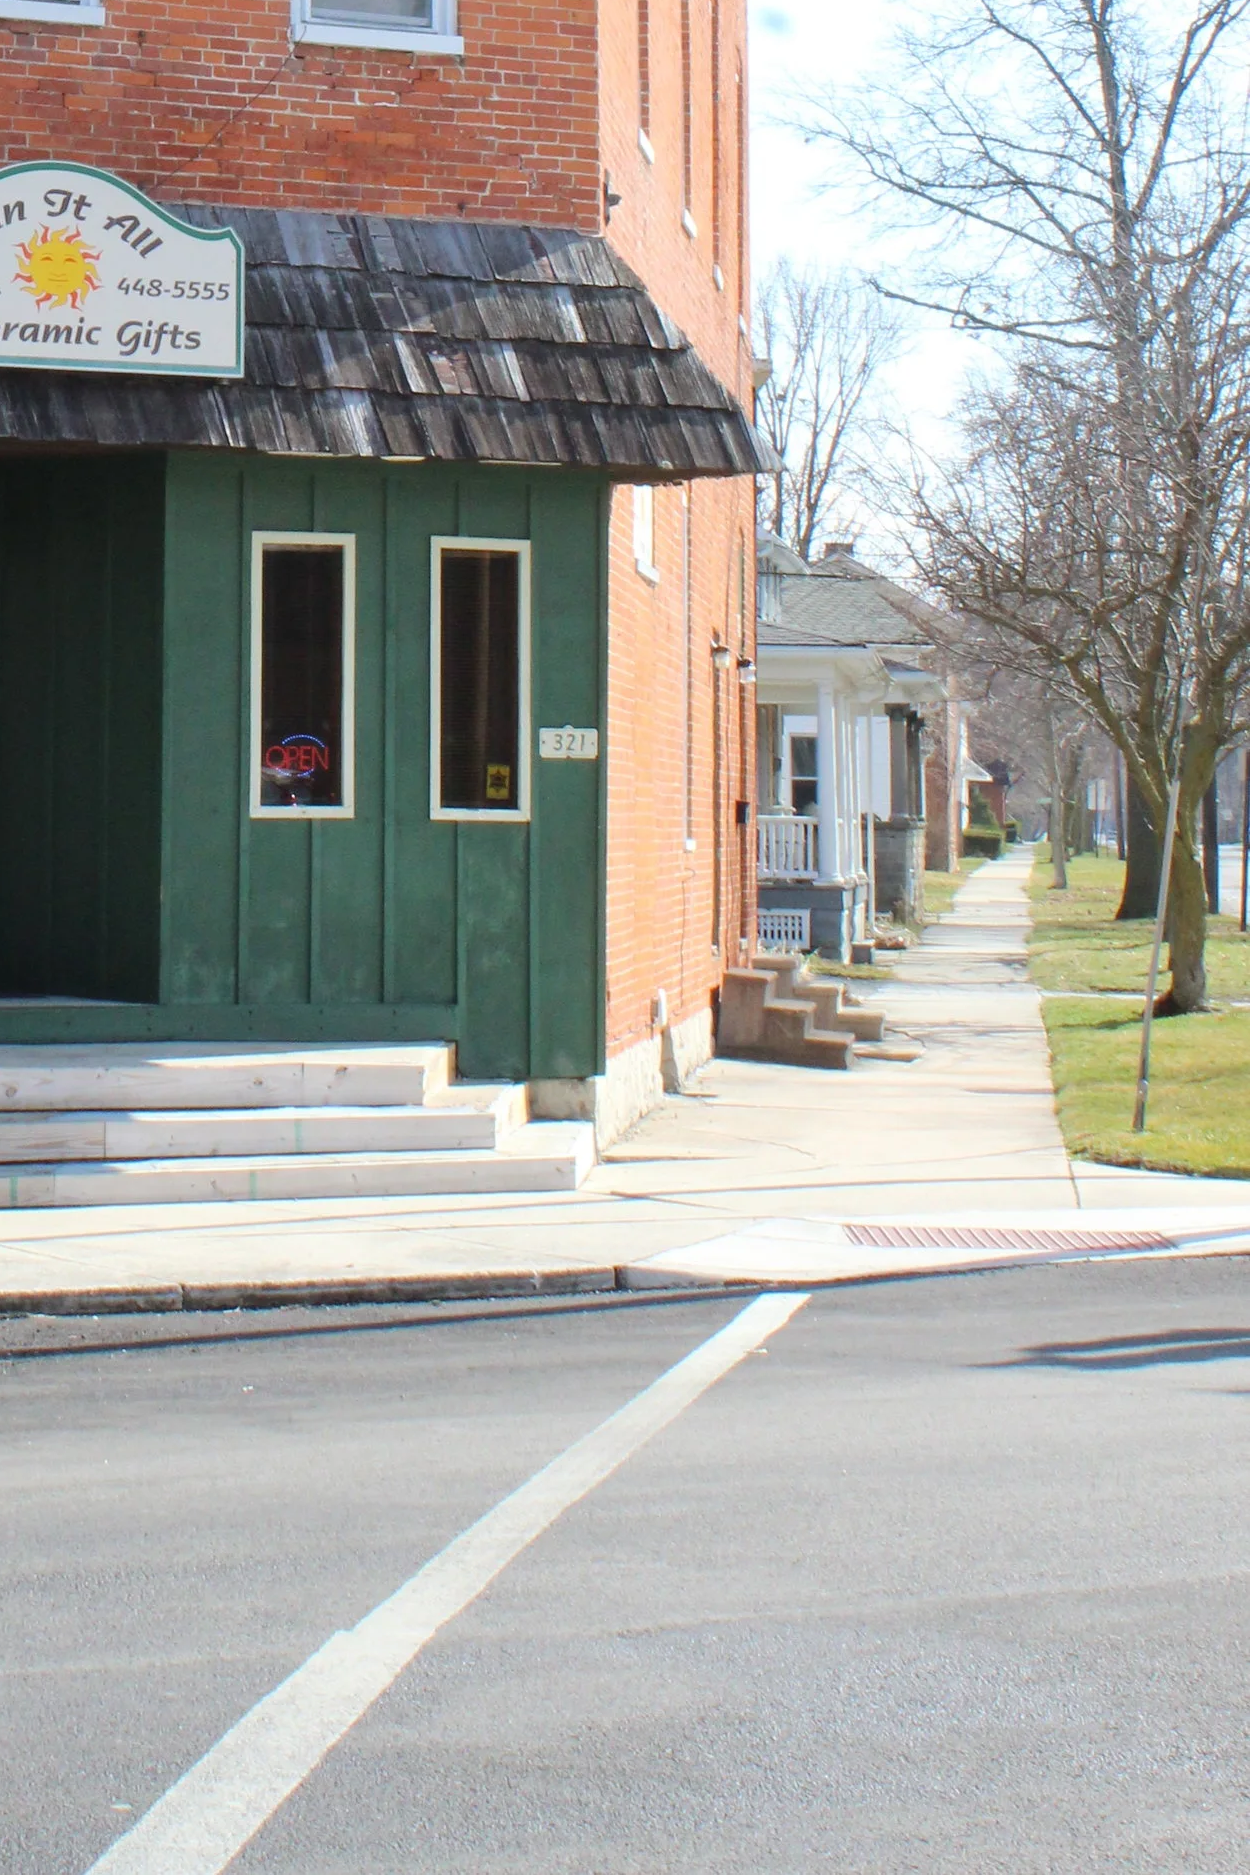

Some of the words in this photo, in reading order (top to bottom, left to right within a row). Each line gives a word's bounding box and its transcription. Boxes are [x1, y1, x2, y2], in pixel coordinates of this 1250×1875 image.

[43, 188, 93, 221] It
[102, 213, 165, 259] All
[116, 276, 231, 301] 448-5555
[115, 318, 202, 356] Gifts
[552, 732, 586, 752] 321
[265, 745, 330, 772] OPEN
